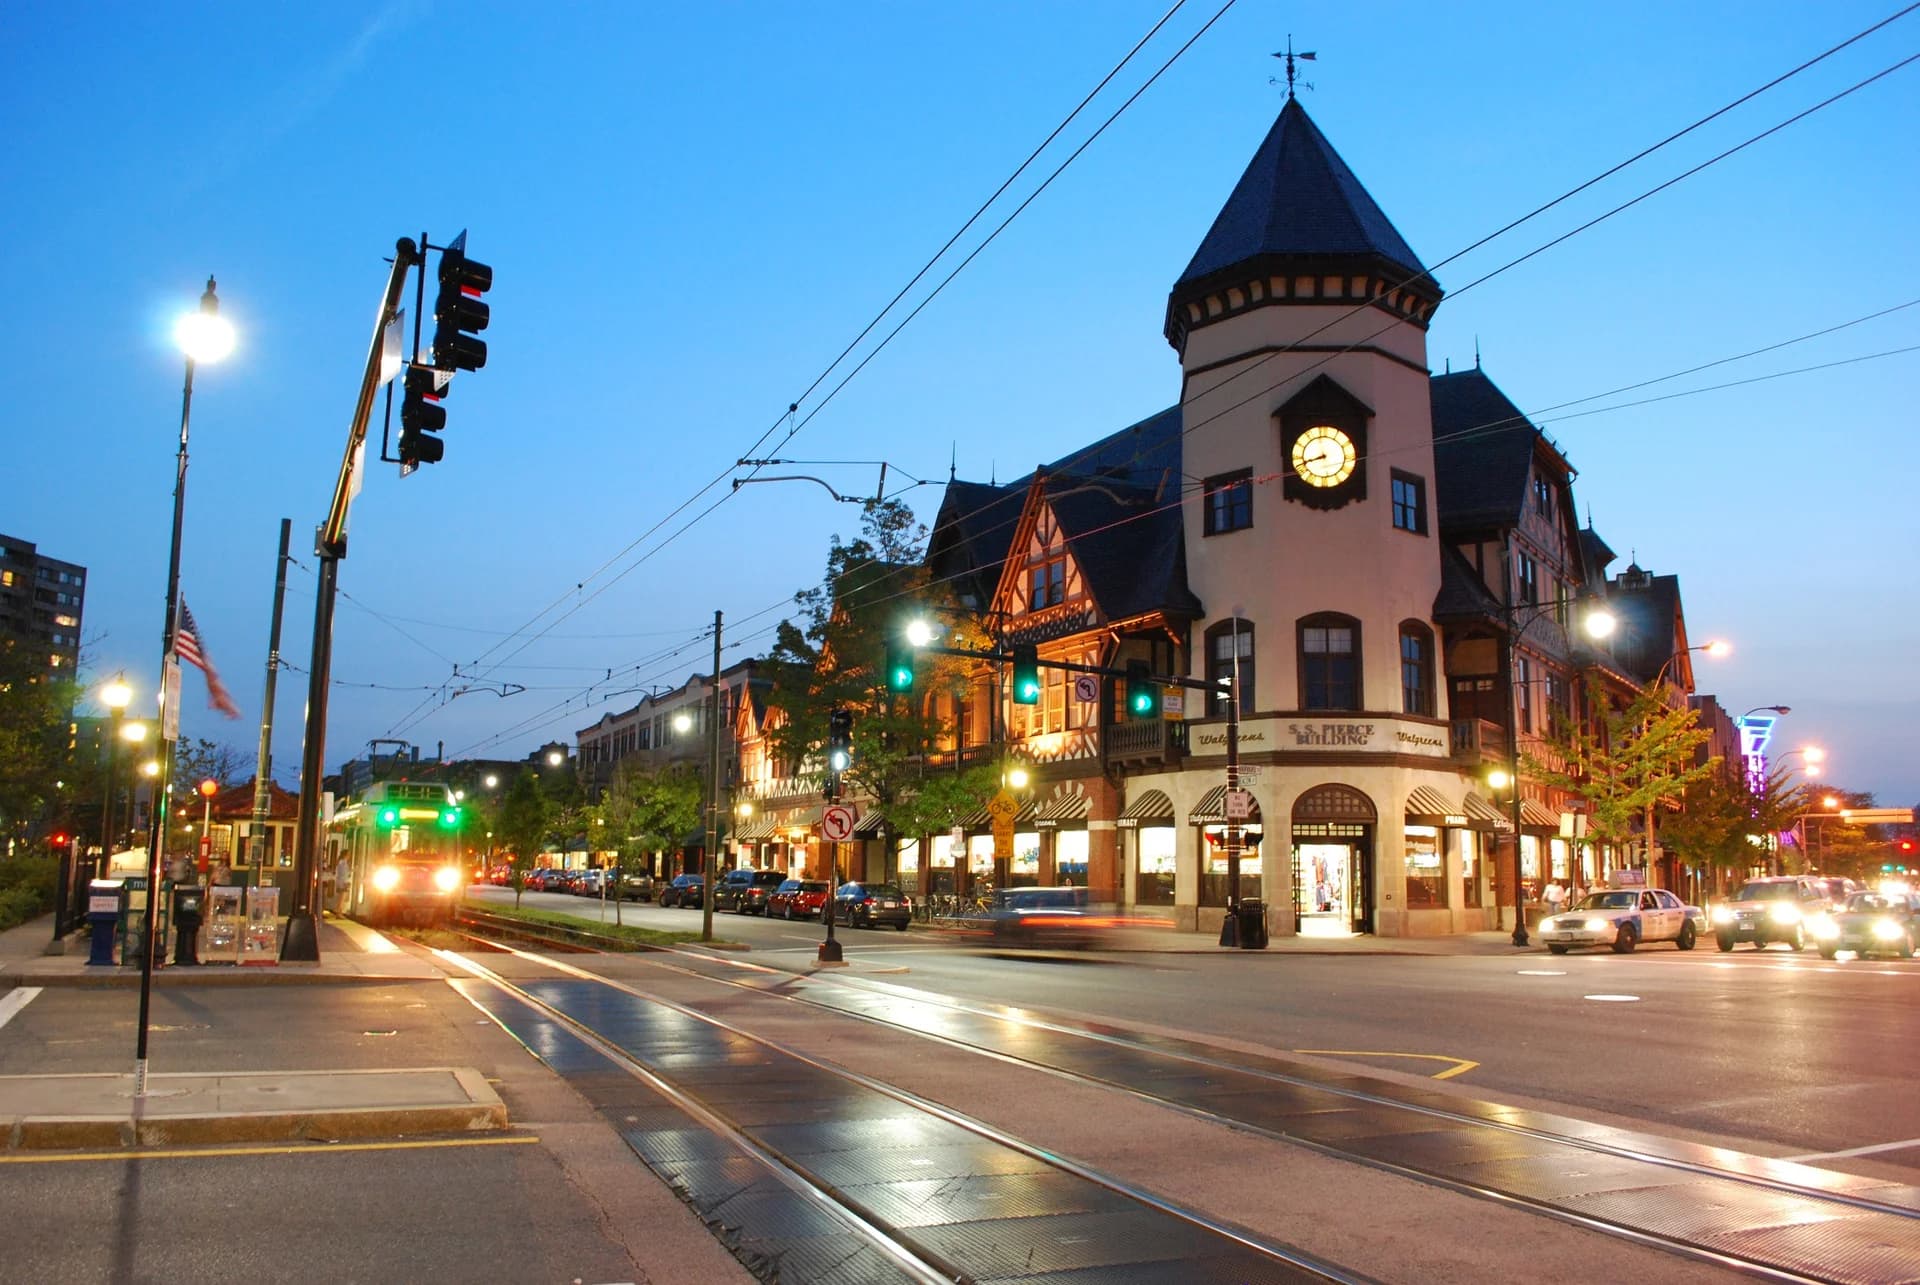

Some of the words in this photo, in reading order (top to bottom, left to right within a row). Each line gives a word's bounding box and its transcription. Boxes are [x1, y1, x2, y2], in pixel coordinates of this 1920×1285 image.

[1288, 724, 1301, 736] S.
[1304, 724, 1317, 736] S.
[1322, 724, 1375, 735] PIERCE
[1198, 732, 1265, 746] Walgeens
[1296, 734, 1368, 745] BUILDING
[1396, 731, 1444, 746] Walgreens
